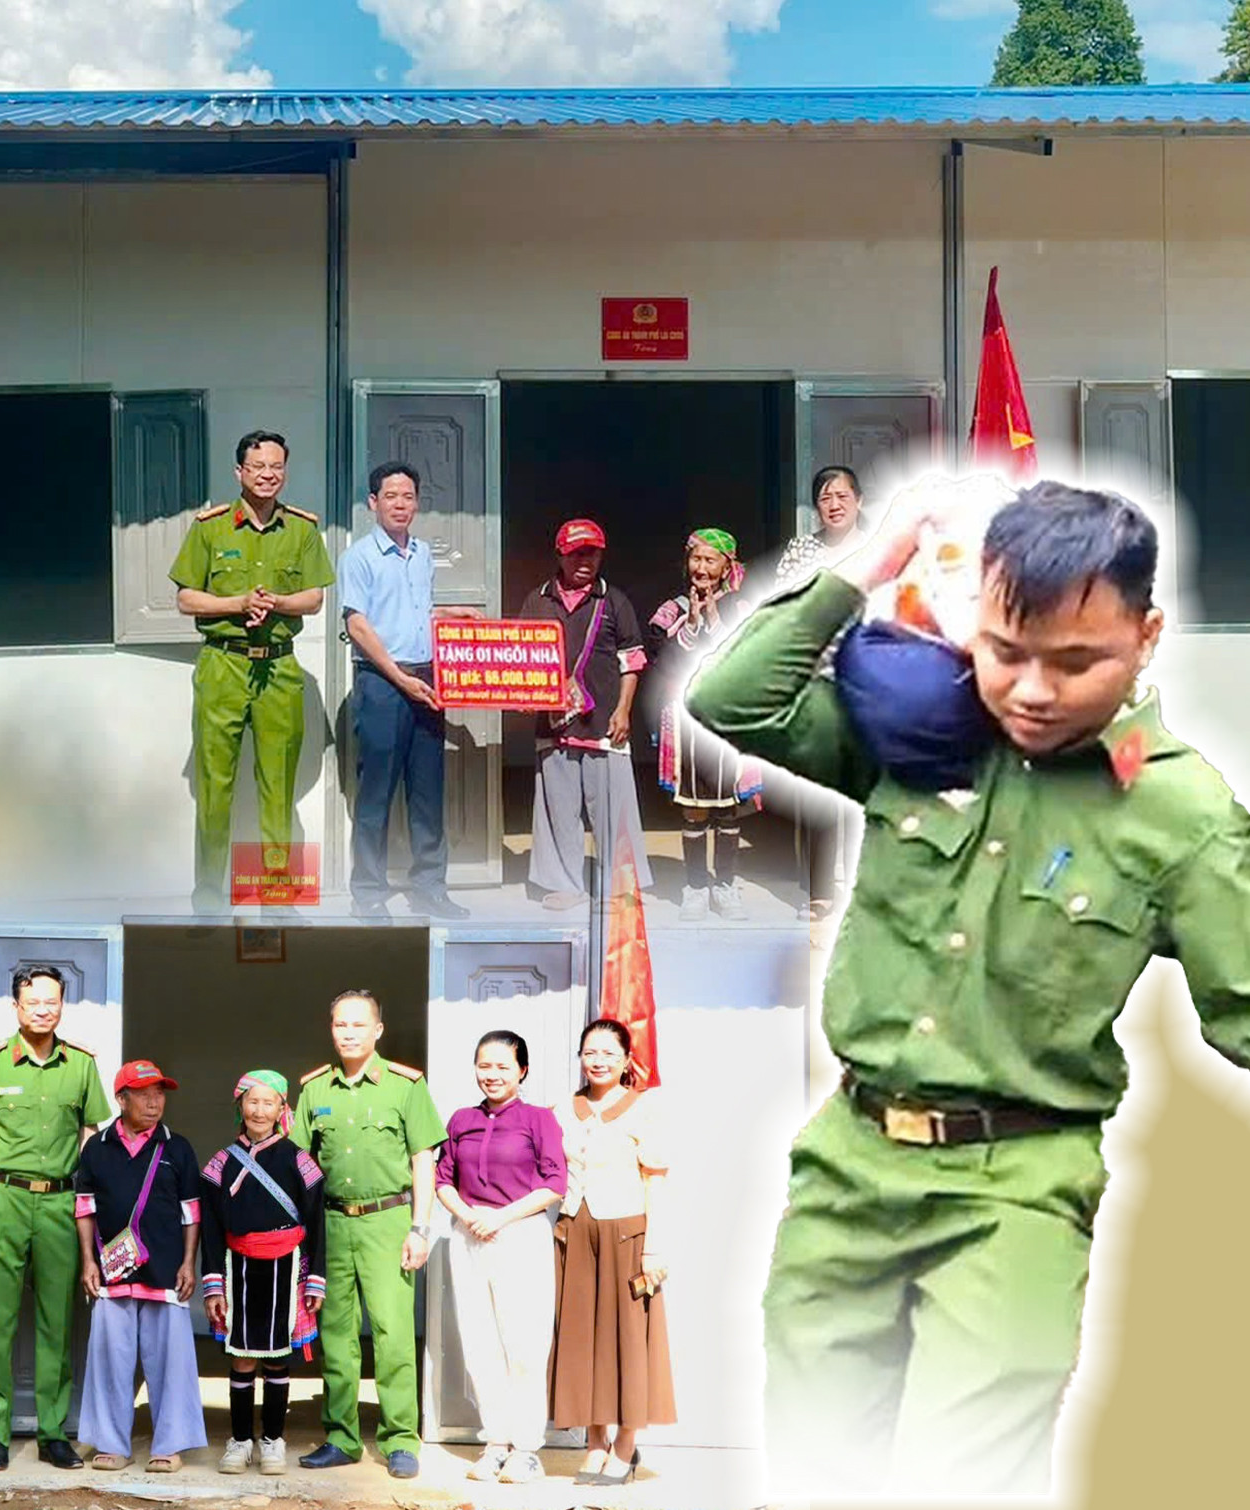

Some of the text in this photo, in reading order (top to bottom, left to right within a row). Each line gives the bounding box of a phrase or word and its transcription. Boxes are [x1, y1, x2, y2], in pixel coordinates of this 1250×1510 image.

[521, 629, 534, 641] LAI
[438, 643, 560, 665] TẶNG 01 NGÔI NHÀ
[441, 669, 458, 687] Trị
[460, 669, 482, 687] giá:
